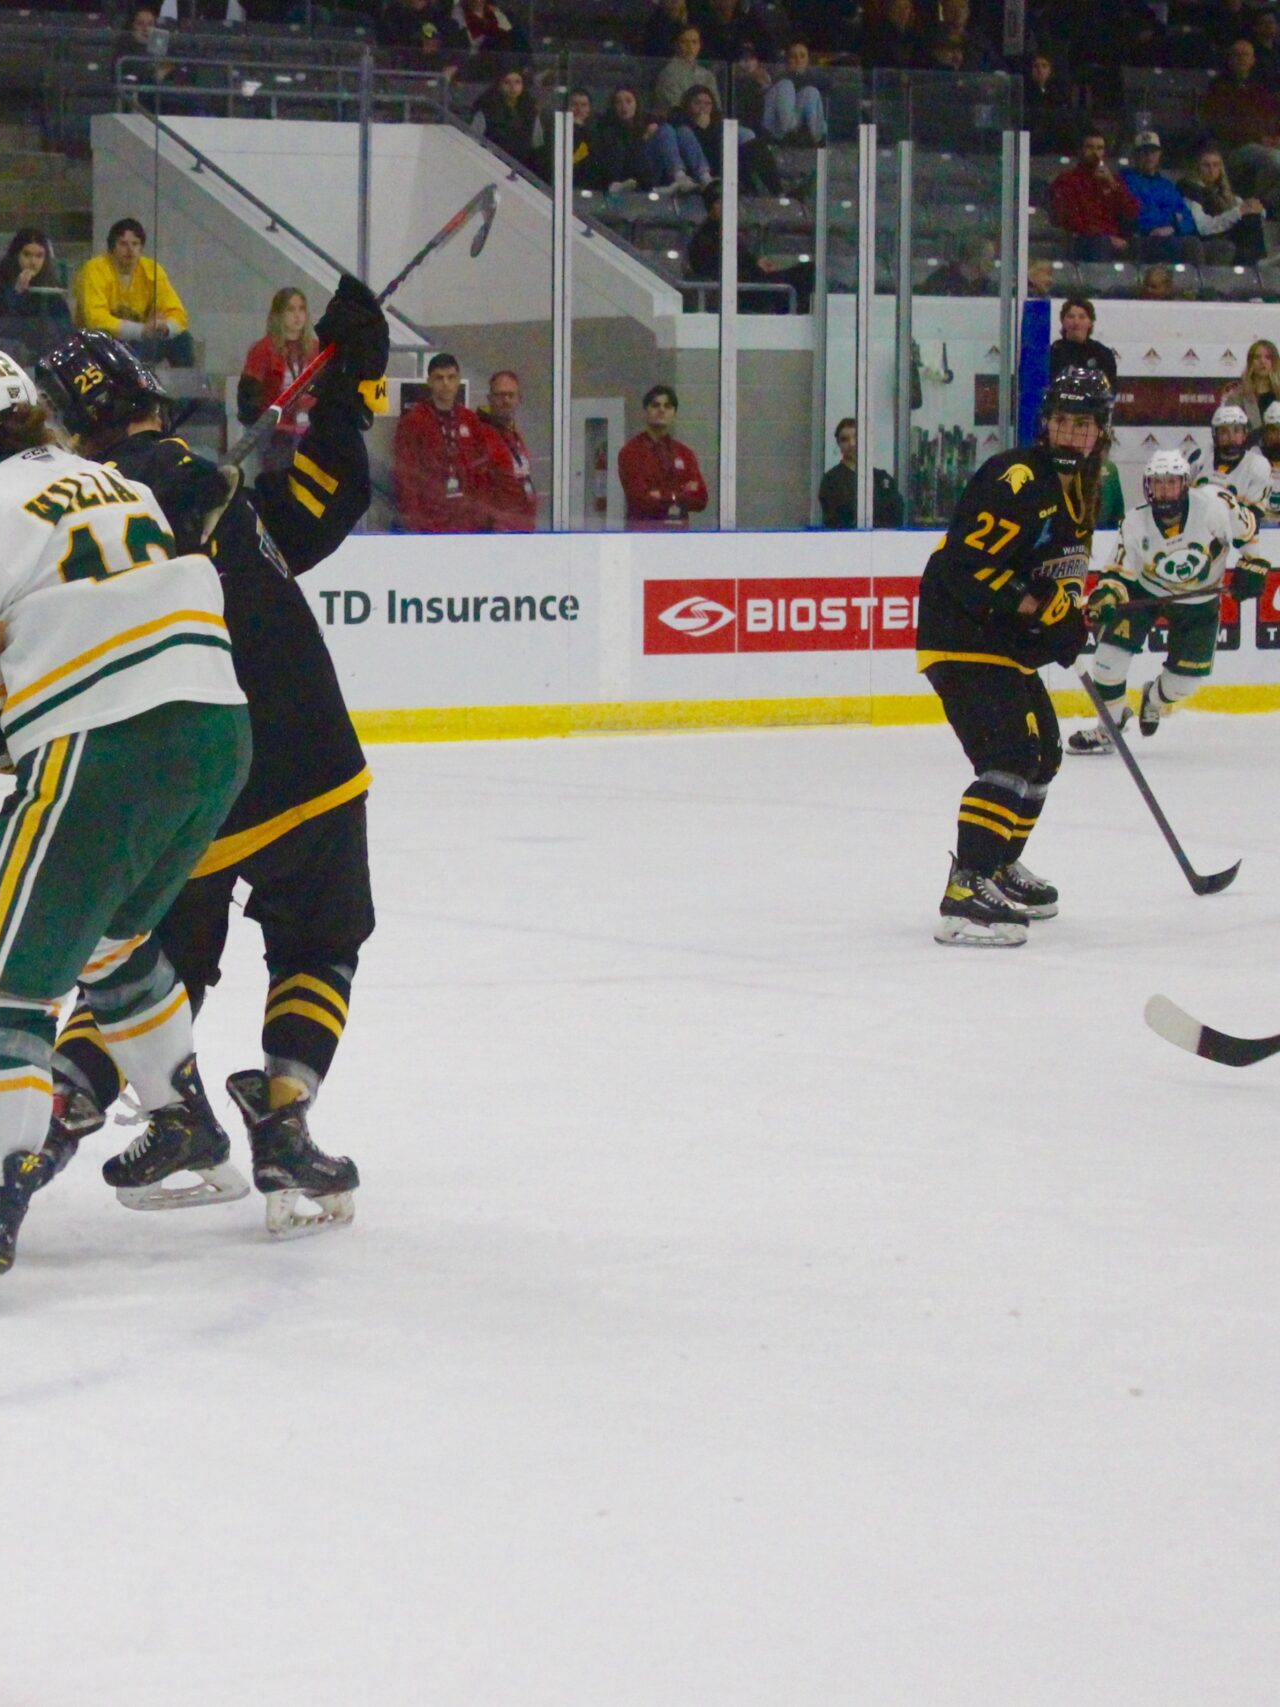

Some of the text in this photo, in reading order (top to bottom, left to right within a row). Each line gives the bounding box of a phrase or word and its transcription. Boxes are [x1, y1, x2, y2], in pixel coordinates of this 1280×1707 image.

[73, 365, 105, 395] 25
[964, 511, 1021, 555] 27
[319, 588, 580, 625] TD Insurance
